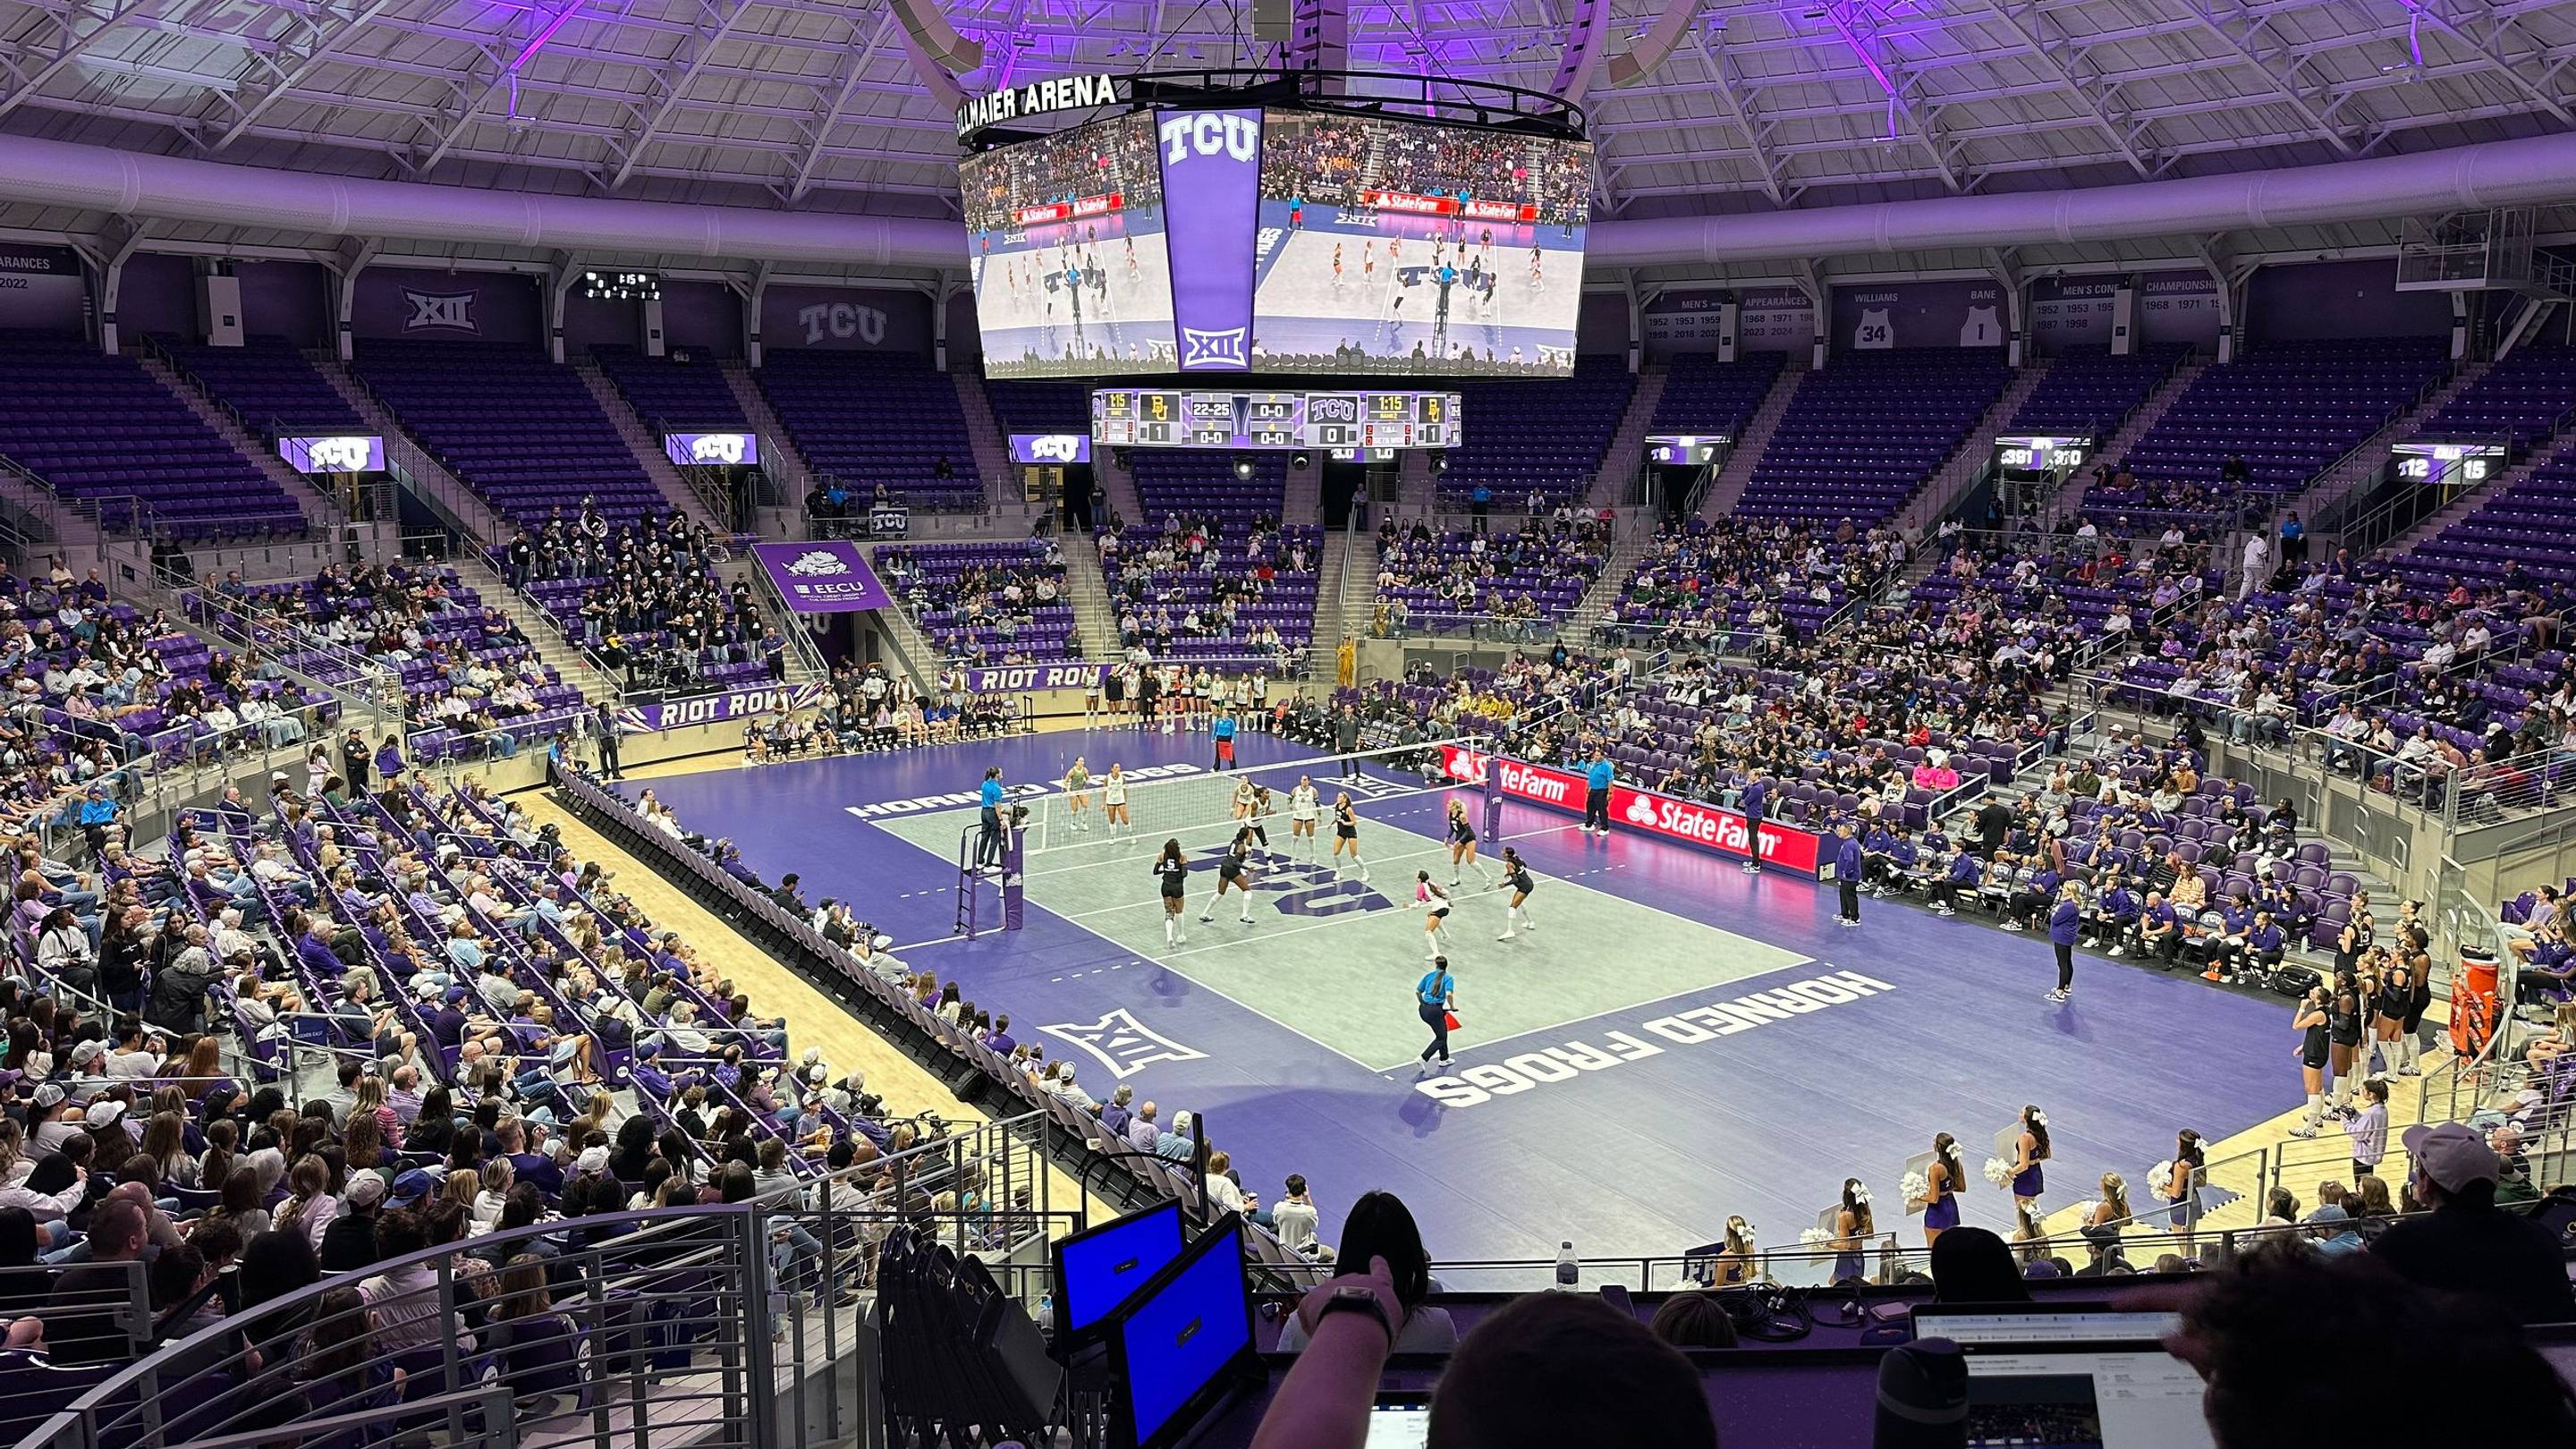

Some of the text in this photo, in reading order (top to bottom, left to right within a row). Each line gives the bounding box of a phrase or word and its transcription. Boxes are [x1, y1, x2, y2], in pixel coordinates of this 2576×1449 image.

[1025, 73, 1116, 114] ARENA
[1161, 114, 1258, 165] TCU
[1854, 290, 1996, 302] WILLIAMS BANE
[2063, 285, 2091, 296] MEN'S
[1682, 301, 1708, 309] MEN'S
[1744, 296, 1808, 308] APPEARANCES
[799, 303, 887, 345] TCU
[1978, 323, 1984, 341] 1
[1862, 326, 1885, 343] 34
[1193, 404, 1230, 416] 22-25
[1260, 405, 1284, 417] 0-0
[1311, 399, 1355, 422] TCU
[1378, 396, 1402, 411] 1:15
[1200, 432, 1222, 444] 0-0
[1261, 433, 1284, 445] 0-0
[1326, 428, 1337, 443] 0
[309, 438, 369, 471] TCU
[692, 435, 745, 463] TCU
[1031, 435, 1079, 462] TCU
[2463, 461, 2486, 479] 15
[873, 513, 906, 530] TCU
[814, 581, 864, 594] EECU
[981, 670, 1038, 691] RIOT
[661, 699, 719, 726] RIOT
[1917, 849, 1933, 859] TCU
[1167, 859, 1175, 869] 5
[1992, 864, 2009, 875] TCU
[2203, 913, 2221, 925] TCU
[1643, 970, 1896, 1045] HORNED
[293, 1021, 299, 1034] 1
[1415, 1030, 1665, 1107] FROGS
